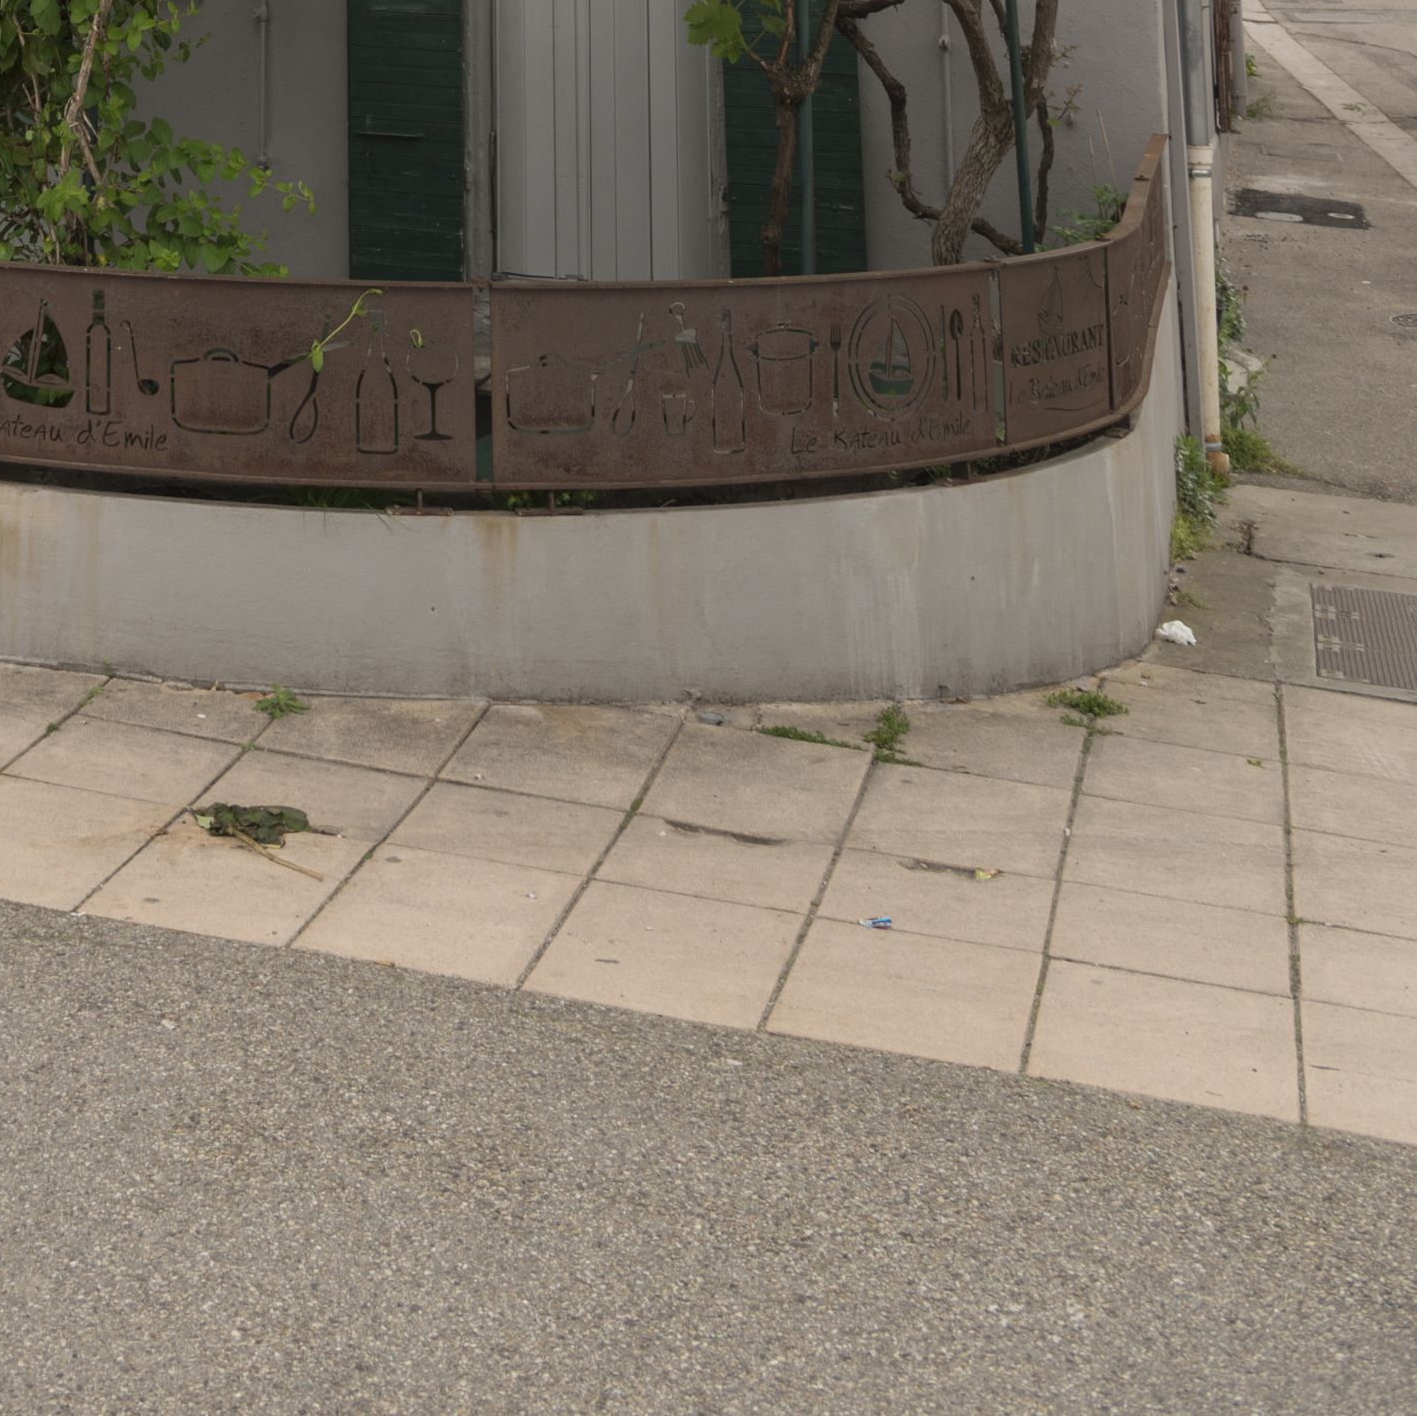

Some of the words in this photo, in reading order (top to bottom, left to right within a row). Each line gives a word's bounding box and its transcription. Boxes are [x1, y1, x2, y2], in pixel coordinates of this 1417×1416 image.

[1010, 323, 1104, 368] RESTAURANT
[77, 420, 168, 452] d'Emile
[791, 425, 818, 455] Le
